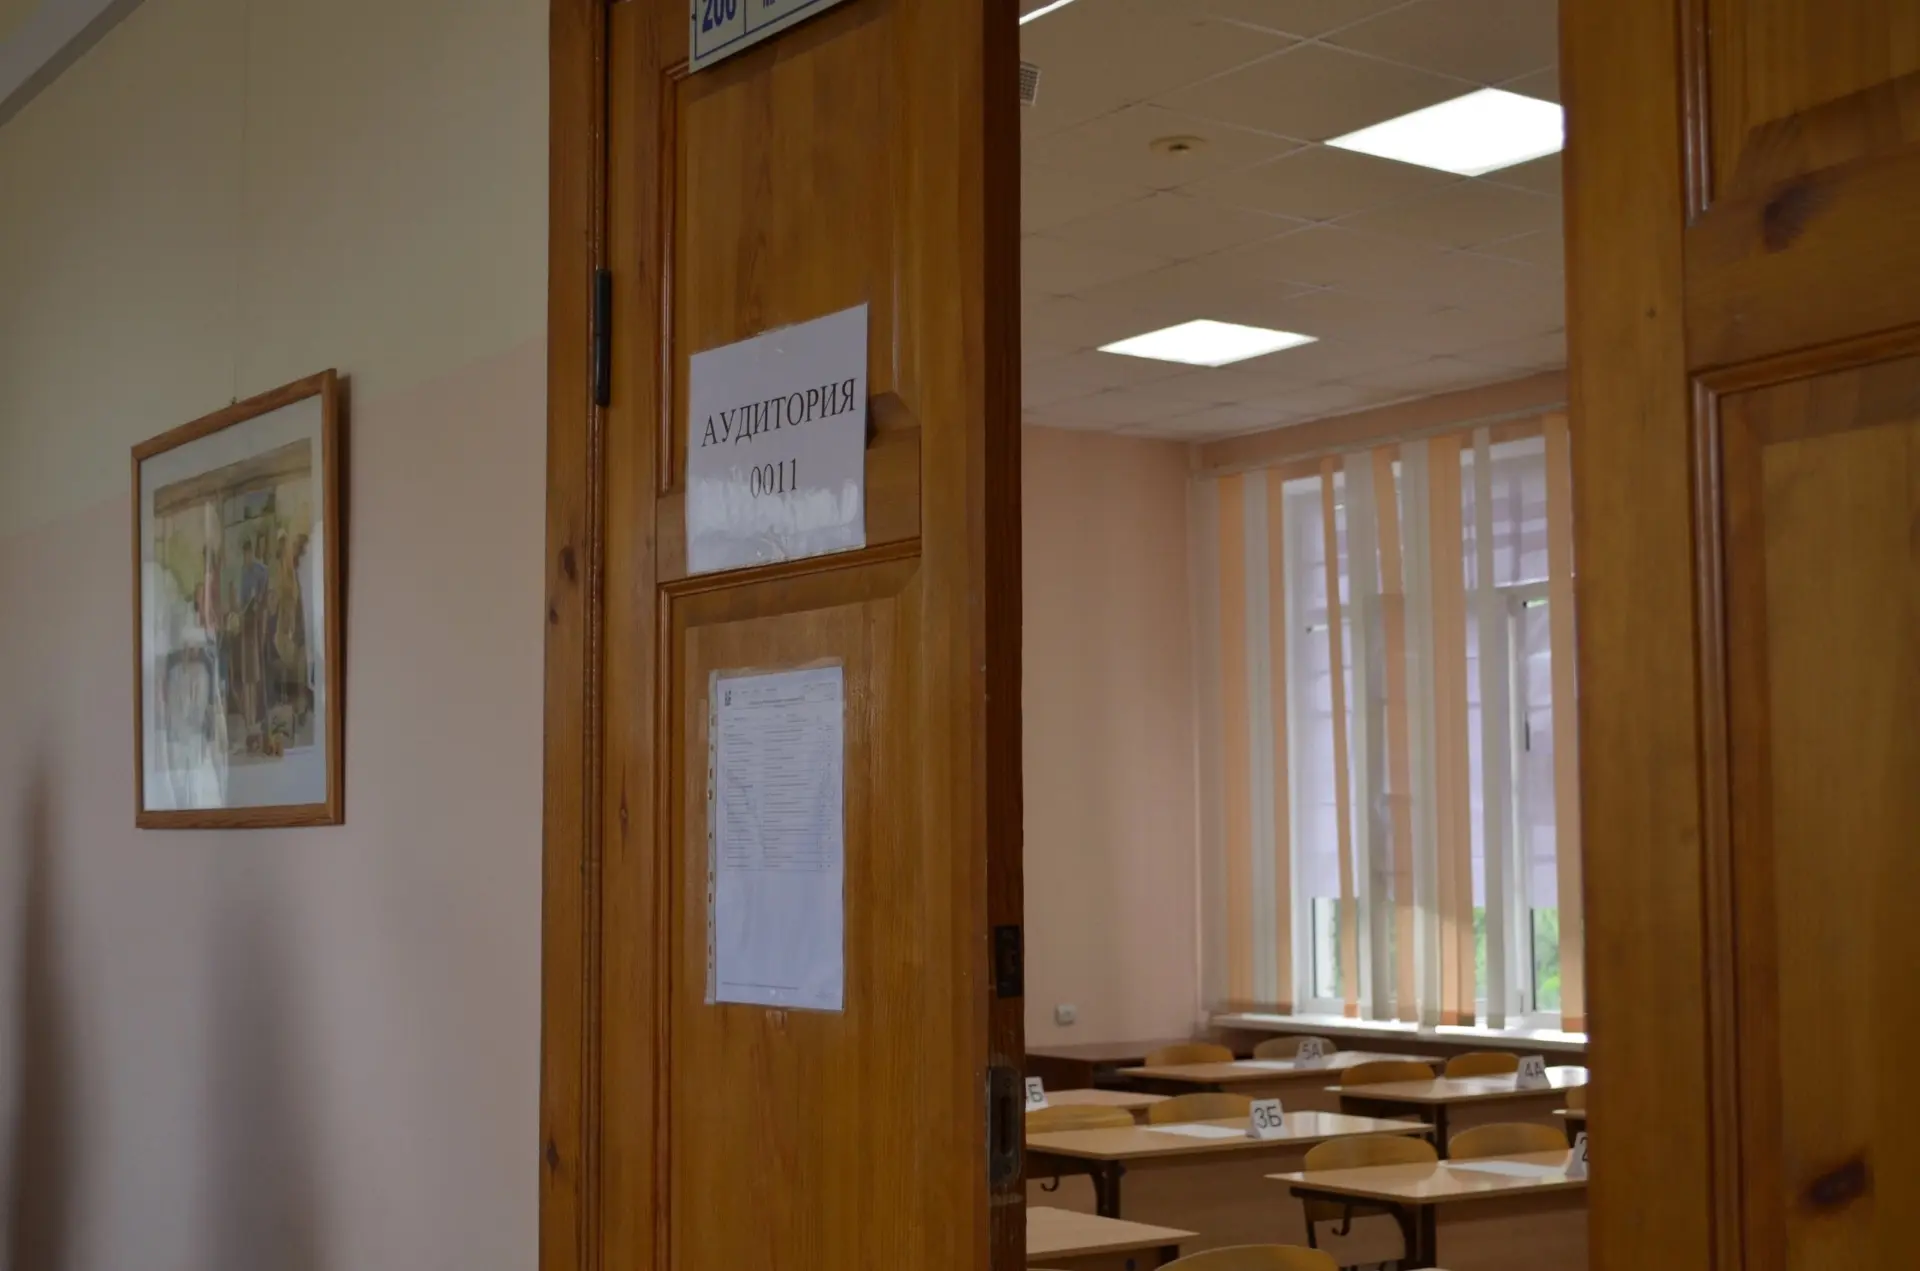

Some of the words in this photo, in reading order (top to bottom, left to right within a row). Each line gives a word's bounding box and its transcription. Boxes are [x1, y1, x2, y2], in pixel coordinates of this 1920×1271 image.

[701, 377, 857, 447] АУДИТОРИЯ
[751, 458, 797, 498] 0011
[1026, 1083, 1044, 1103] Б
[1253, 1106, 1282, 1129] 3Б
